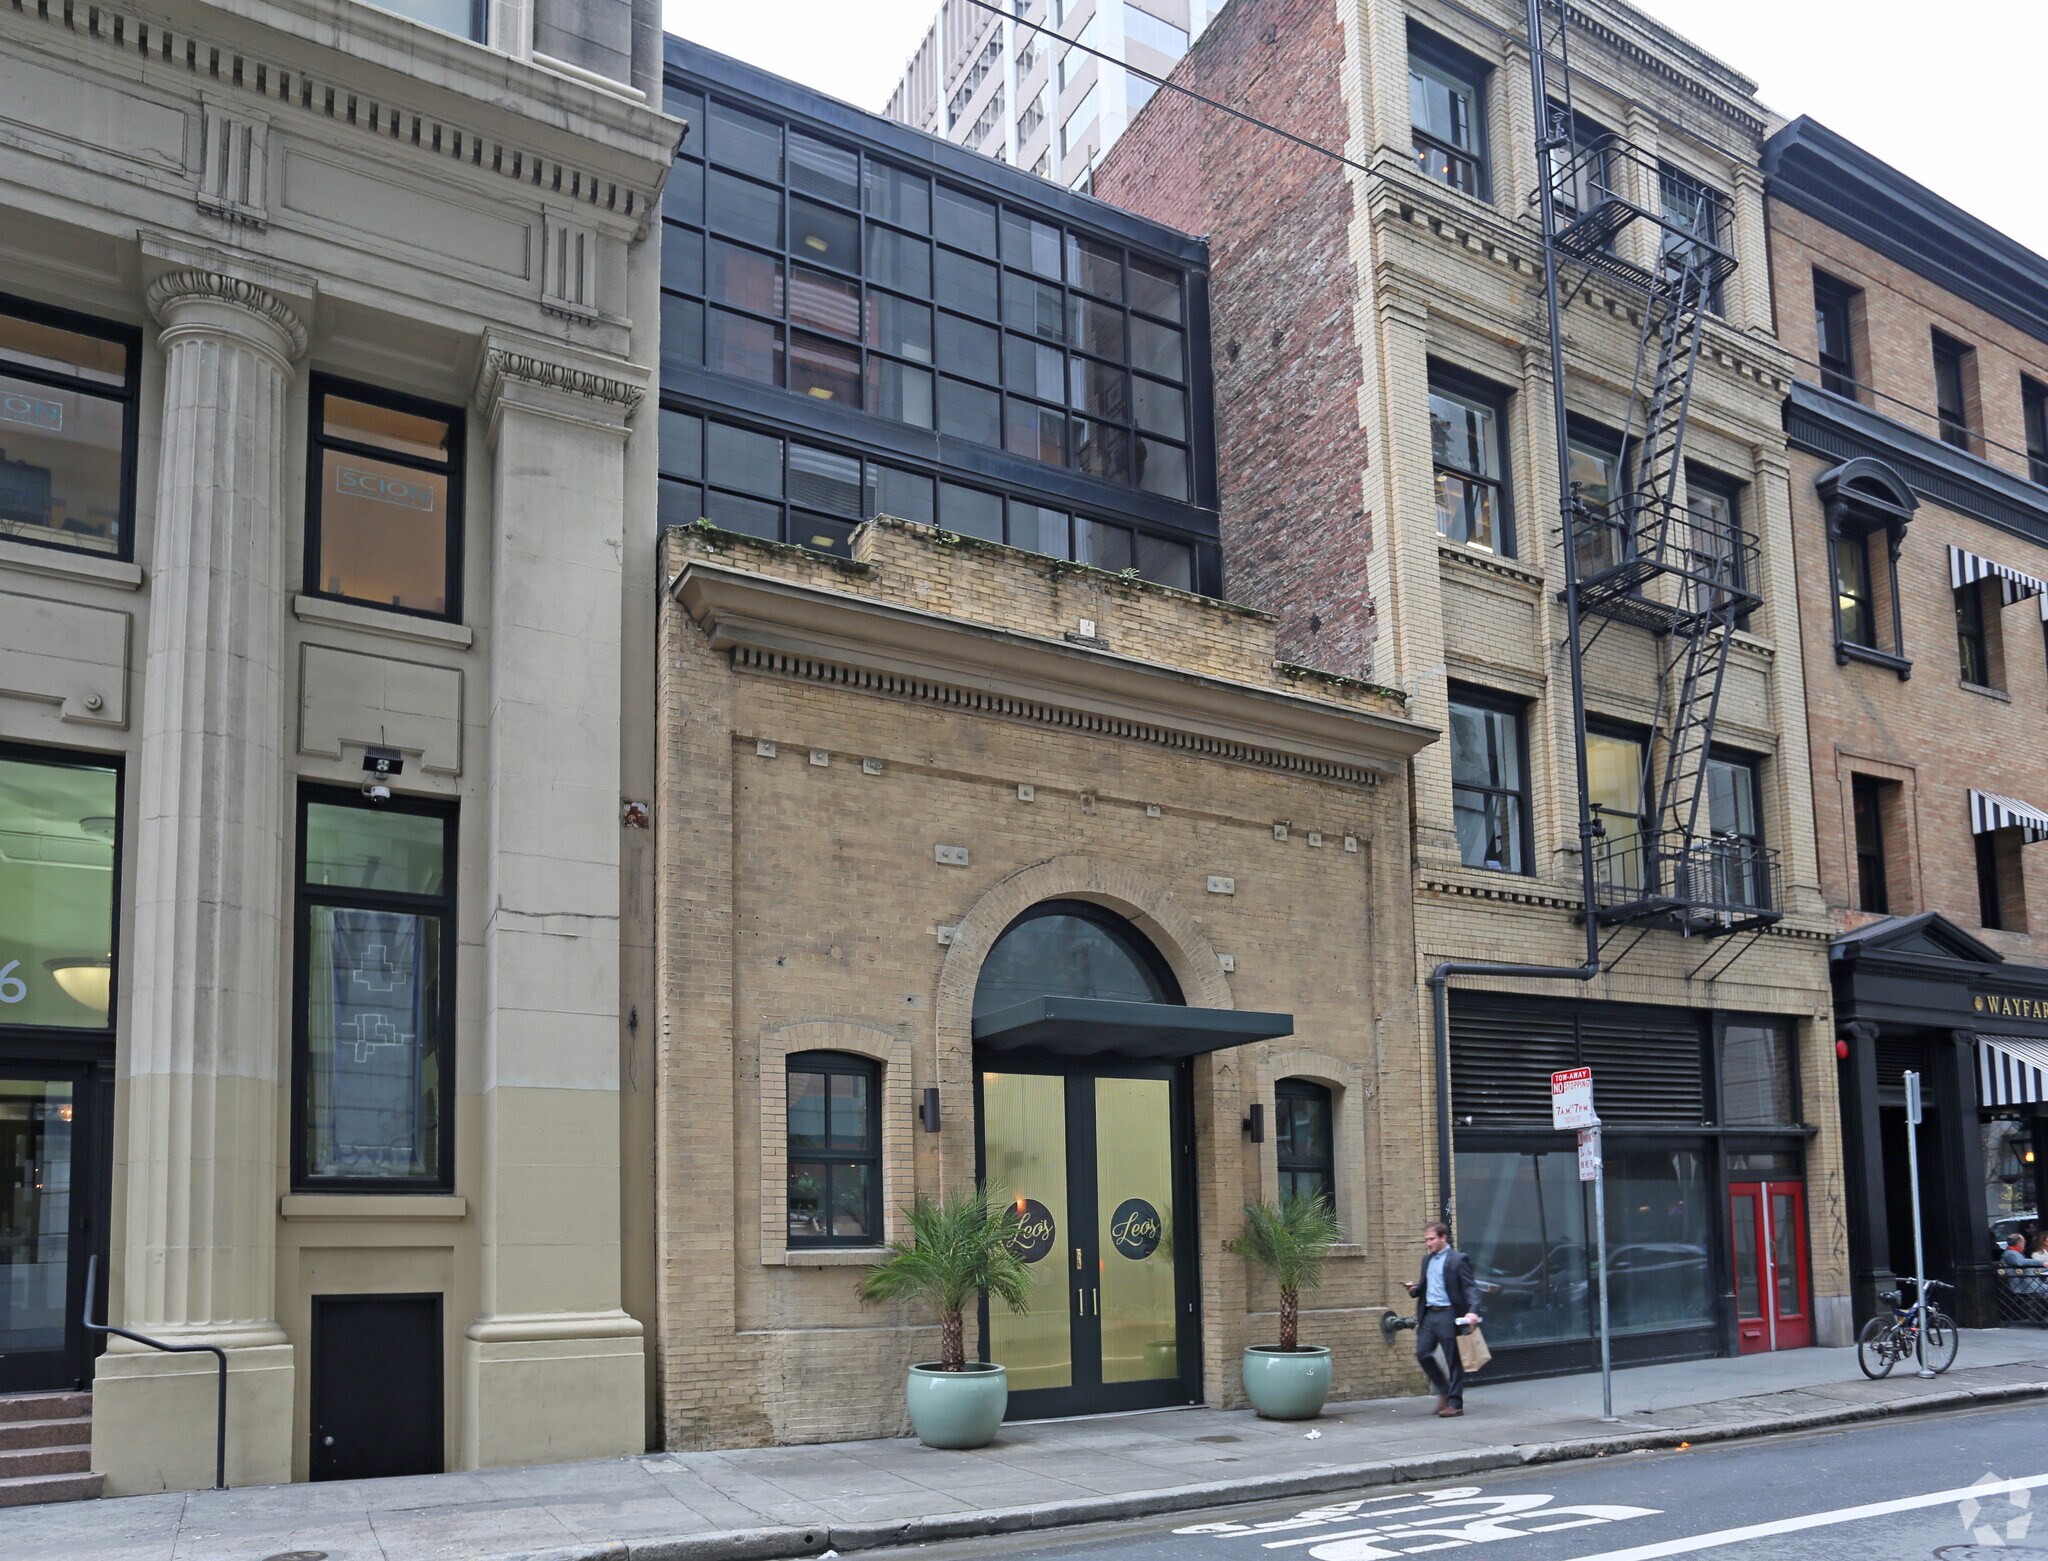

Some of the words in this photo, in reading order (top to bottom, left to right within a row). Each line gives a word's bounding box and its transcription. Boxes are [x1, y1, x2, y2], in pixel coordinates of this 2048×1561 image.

[0, 959, 27, 1004] 6
[1555, 1071, 1587, 1082] TOW-AWAY
[1554, 1082, 1563, 1094] NO
[1565, 1080, 1590, 1091] STOPPING
